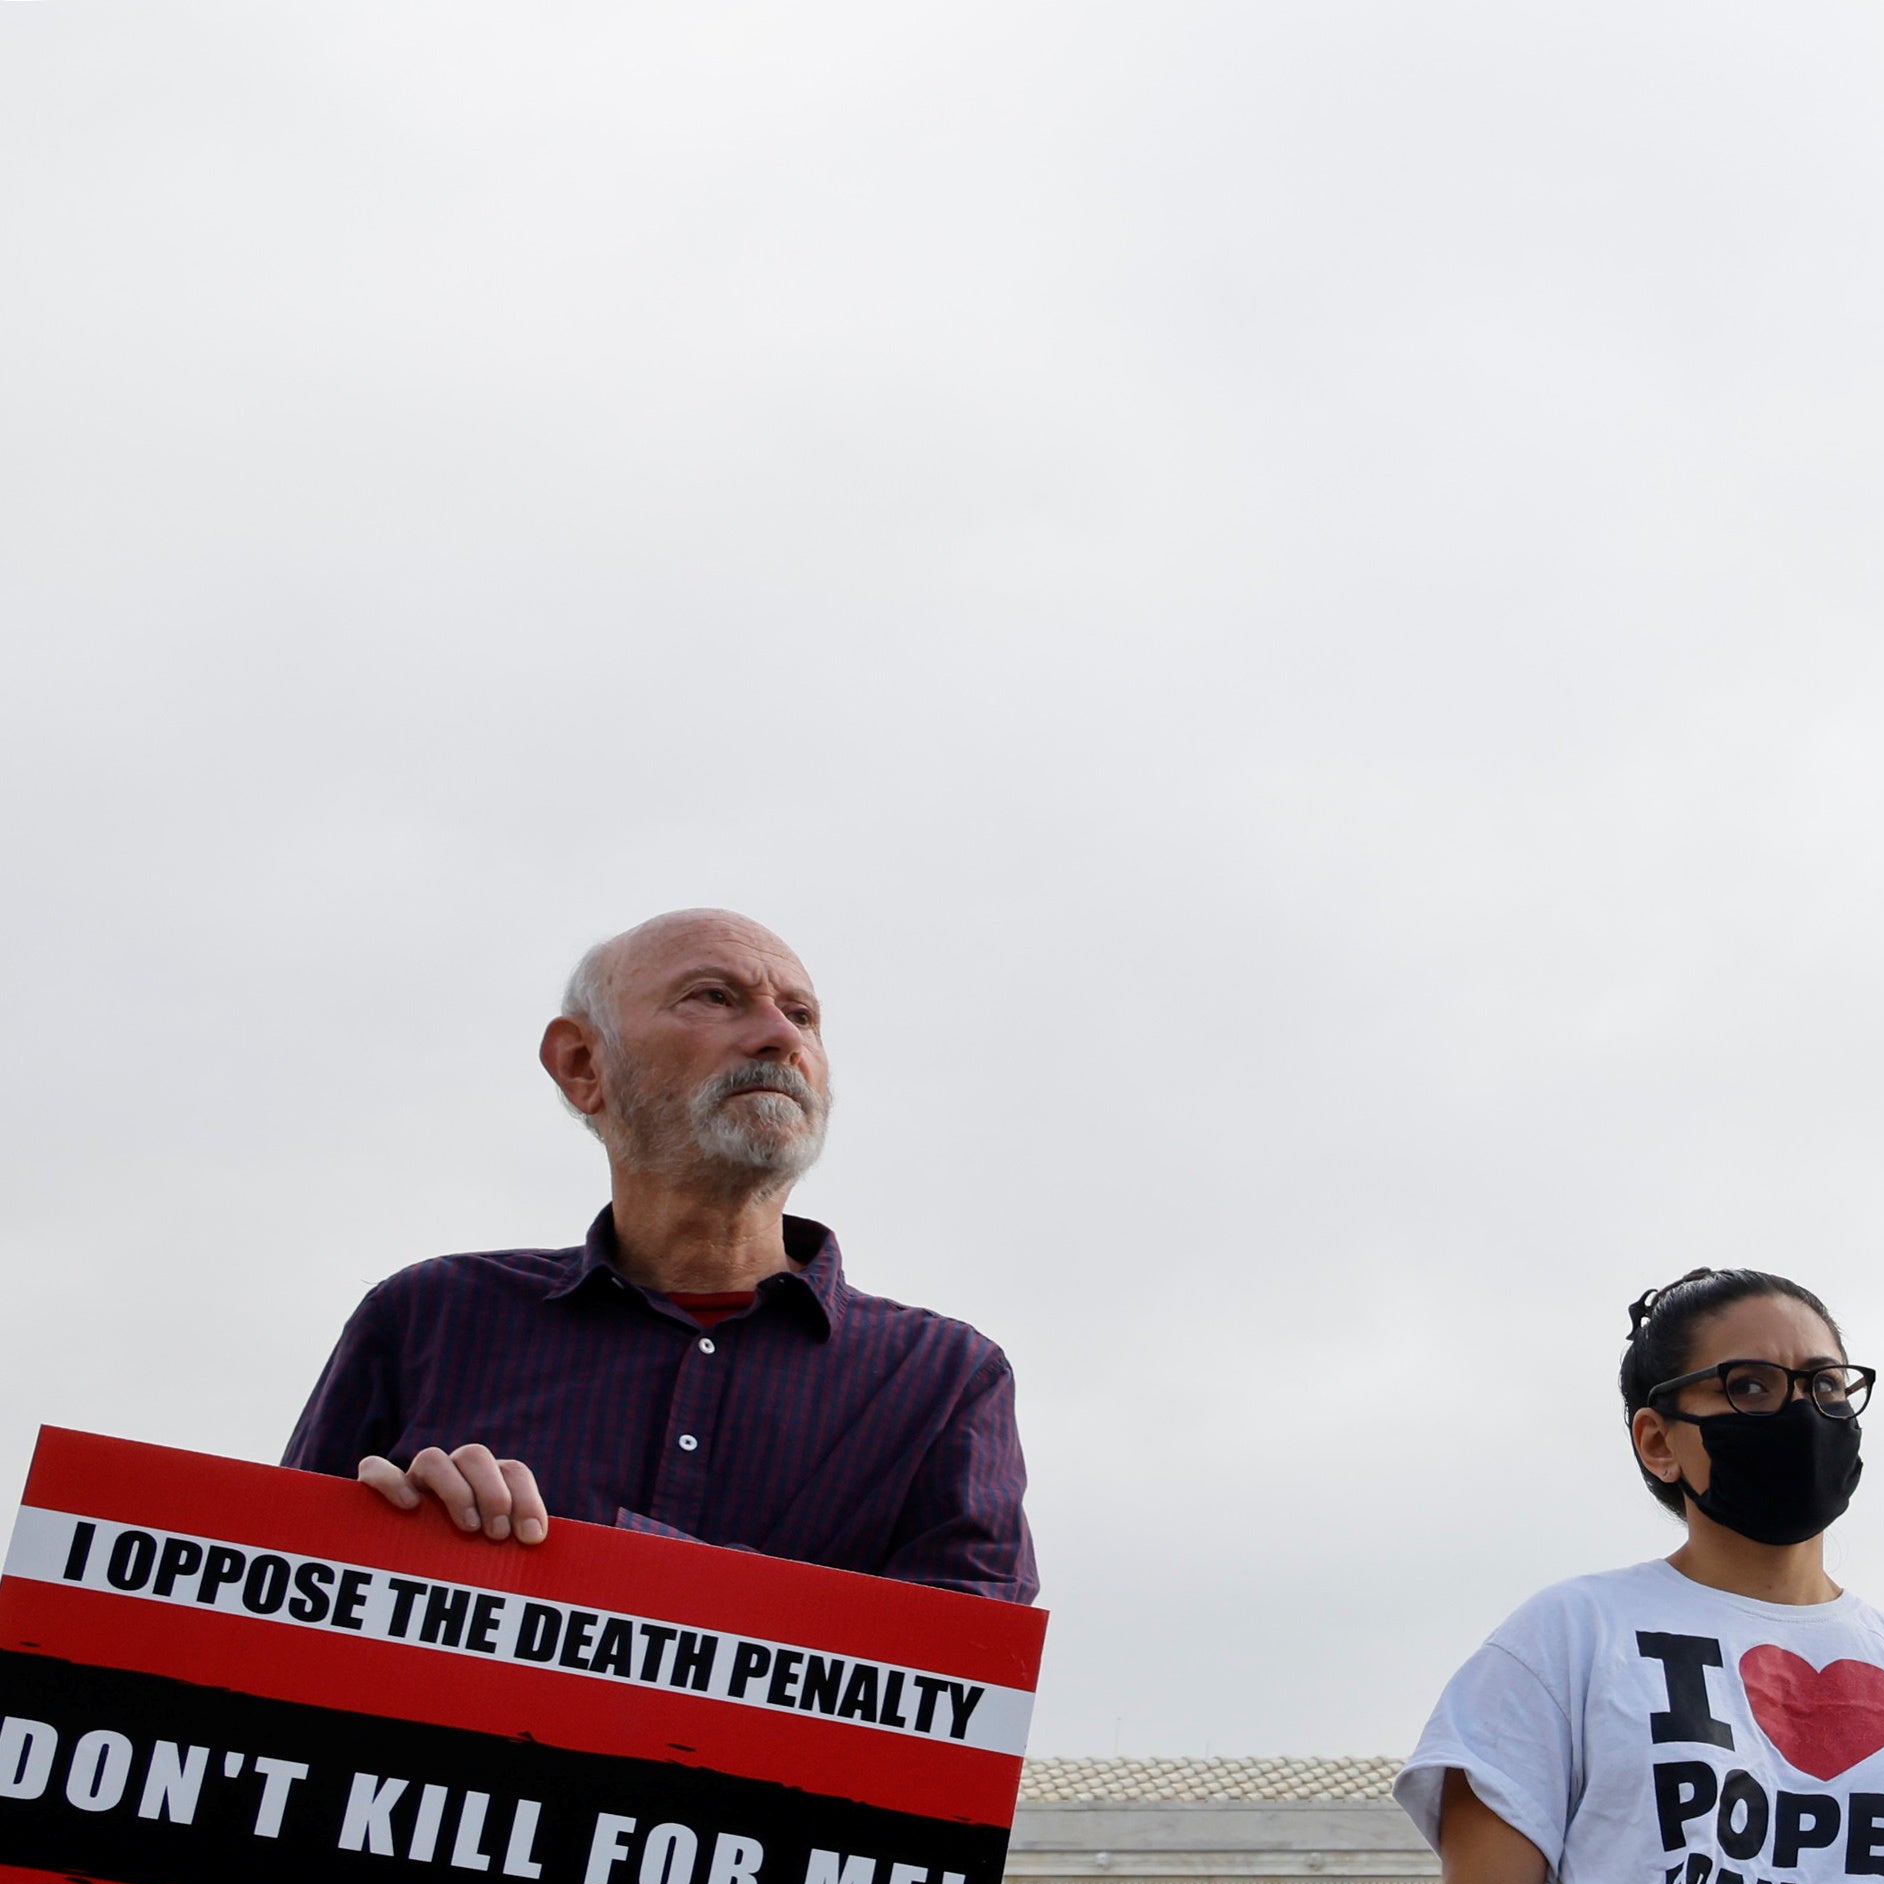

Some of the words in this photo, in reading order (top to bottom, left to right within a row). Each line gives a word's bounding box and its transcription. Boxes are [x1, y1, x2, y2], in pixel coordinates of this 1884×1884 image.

[62, 1521, 97, 1581] I
[106, 1529, 373, 1631] OPPOSE
[387, 1577, 506, 1655] THE
[513, 1602, 719, 1692] DEATH
[727, 1641, 985, 1740] PENALTY
[1635, 1630, 1735, 1752] I
[0, 1715, 310, 1839] DON'T
[338, 1771, 543, 1880] KILL
